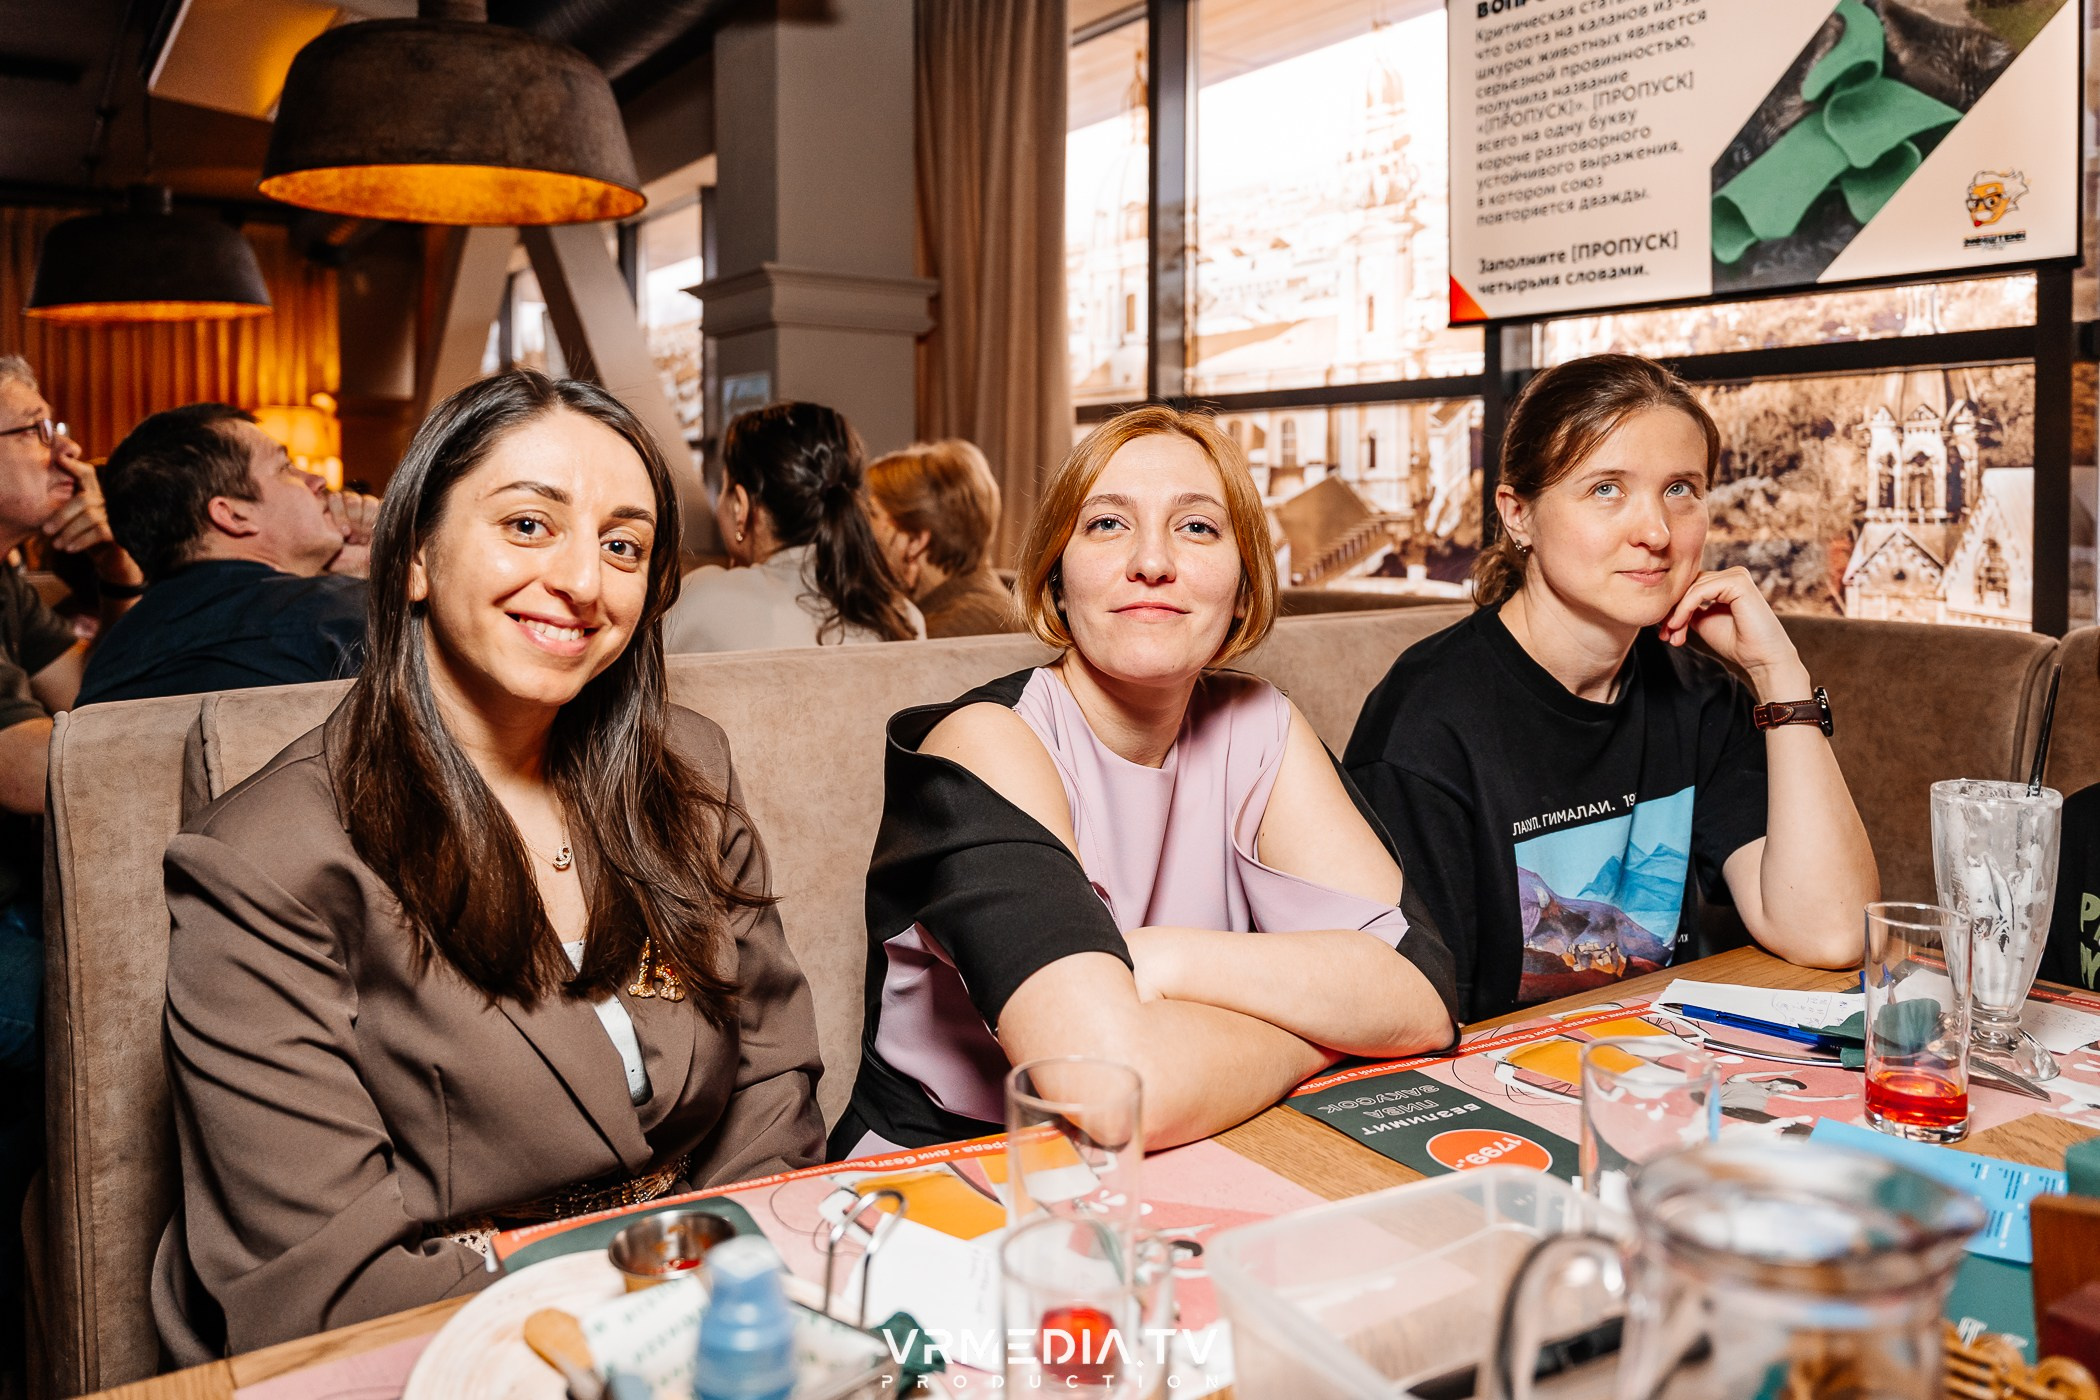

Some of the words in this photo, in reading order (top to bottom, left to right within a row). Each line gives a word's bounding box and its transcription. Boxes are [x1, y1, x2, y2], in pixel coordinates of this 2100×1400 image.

[1475, 5, 1575, 43] Критическая
[1475, 44, 1502, 59] что
[1504, 32, 1551, 54] охота
[1555, 24, 1574, 39] на
[1578, 5, 1648, 32] каланов
[1475, 56, 1533, 81] шкурок
[1538, 34, 1621, 64] животных
[1626, 9, 1707, 41] является
[1475, 90, 1548, 117] получила
[1553, 70, 1629, 98] название
[1592, 70, 1694, 112] [ПРОПУСК]
[1476, 134, 1518, 155] всего
[1520, 129, 1541, 144] на
[1543, 119, 1584, 139] одну
[1588, 108, 1637, 131] букву
[1476, 150, 1531, 172] короче
[1535, 125, 1652, 164] разговорного
[1476, 160, 1576, 194] устойчивого
[1477, 197, 1485, 209] в
[1488, 183, 1556, 206] котором
[1560, 174, 1603, 194] союз
[1476, 199, 1575, 227] повторяется
[1478, 250, 1566, 275] Заполните
[1571, 228, 1679, 265] [ПРОПУСК]
[1478, 275, 1560, 297] четырьмя
[1565, 263, 1649, 287] словами.
[1542, 800, 1616, 828] ГИМАЛАИ.
[1622, 793, 1637, 808] 19
[1533, 1026, 1556, 1038] дни
[1318, 1084, 1440, 1114] ЗАКУСОК
[1363, 1099, 1439, 1119] ПИВА
[1361, 1102, 1482, 1136] БЕЗЛИМИТ
[917, 1148, 951, 1162] дни
